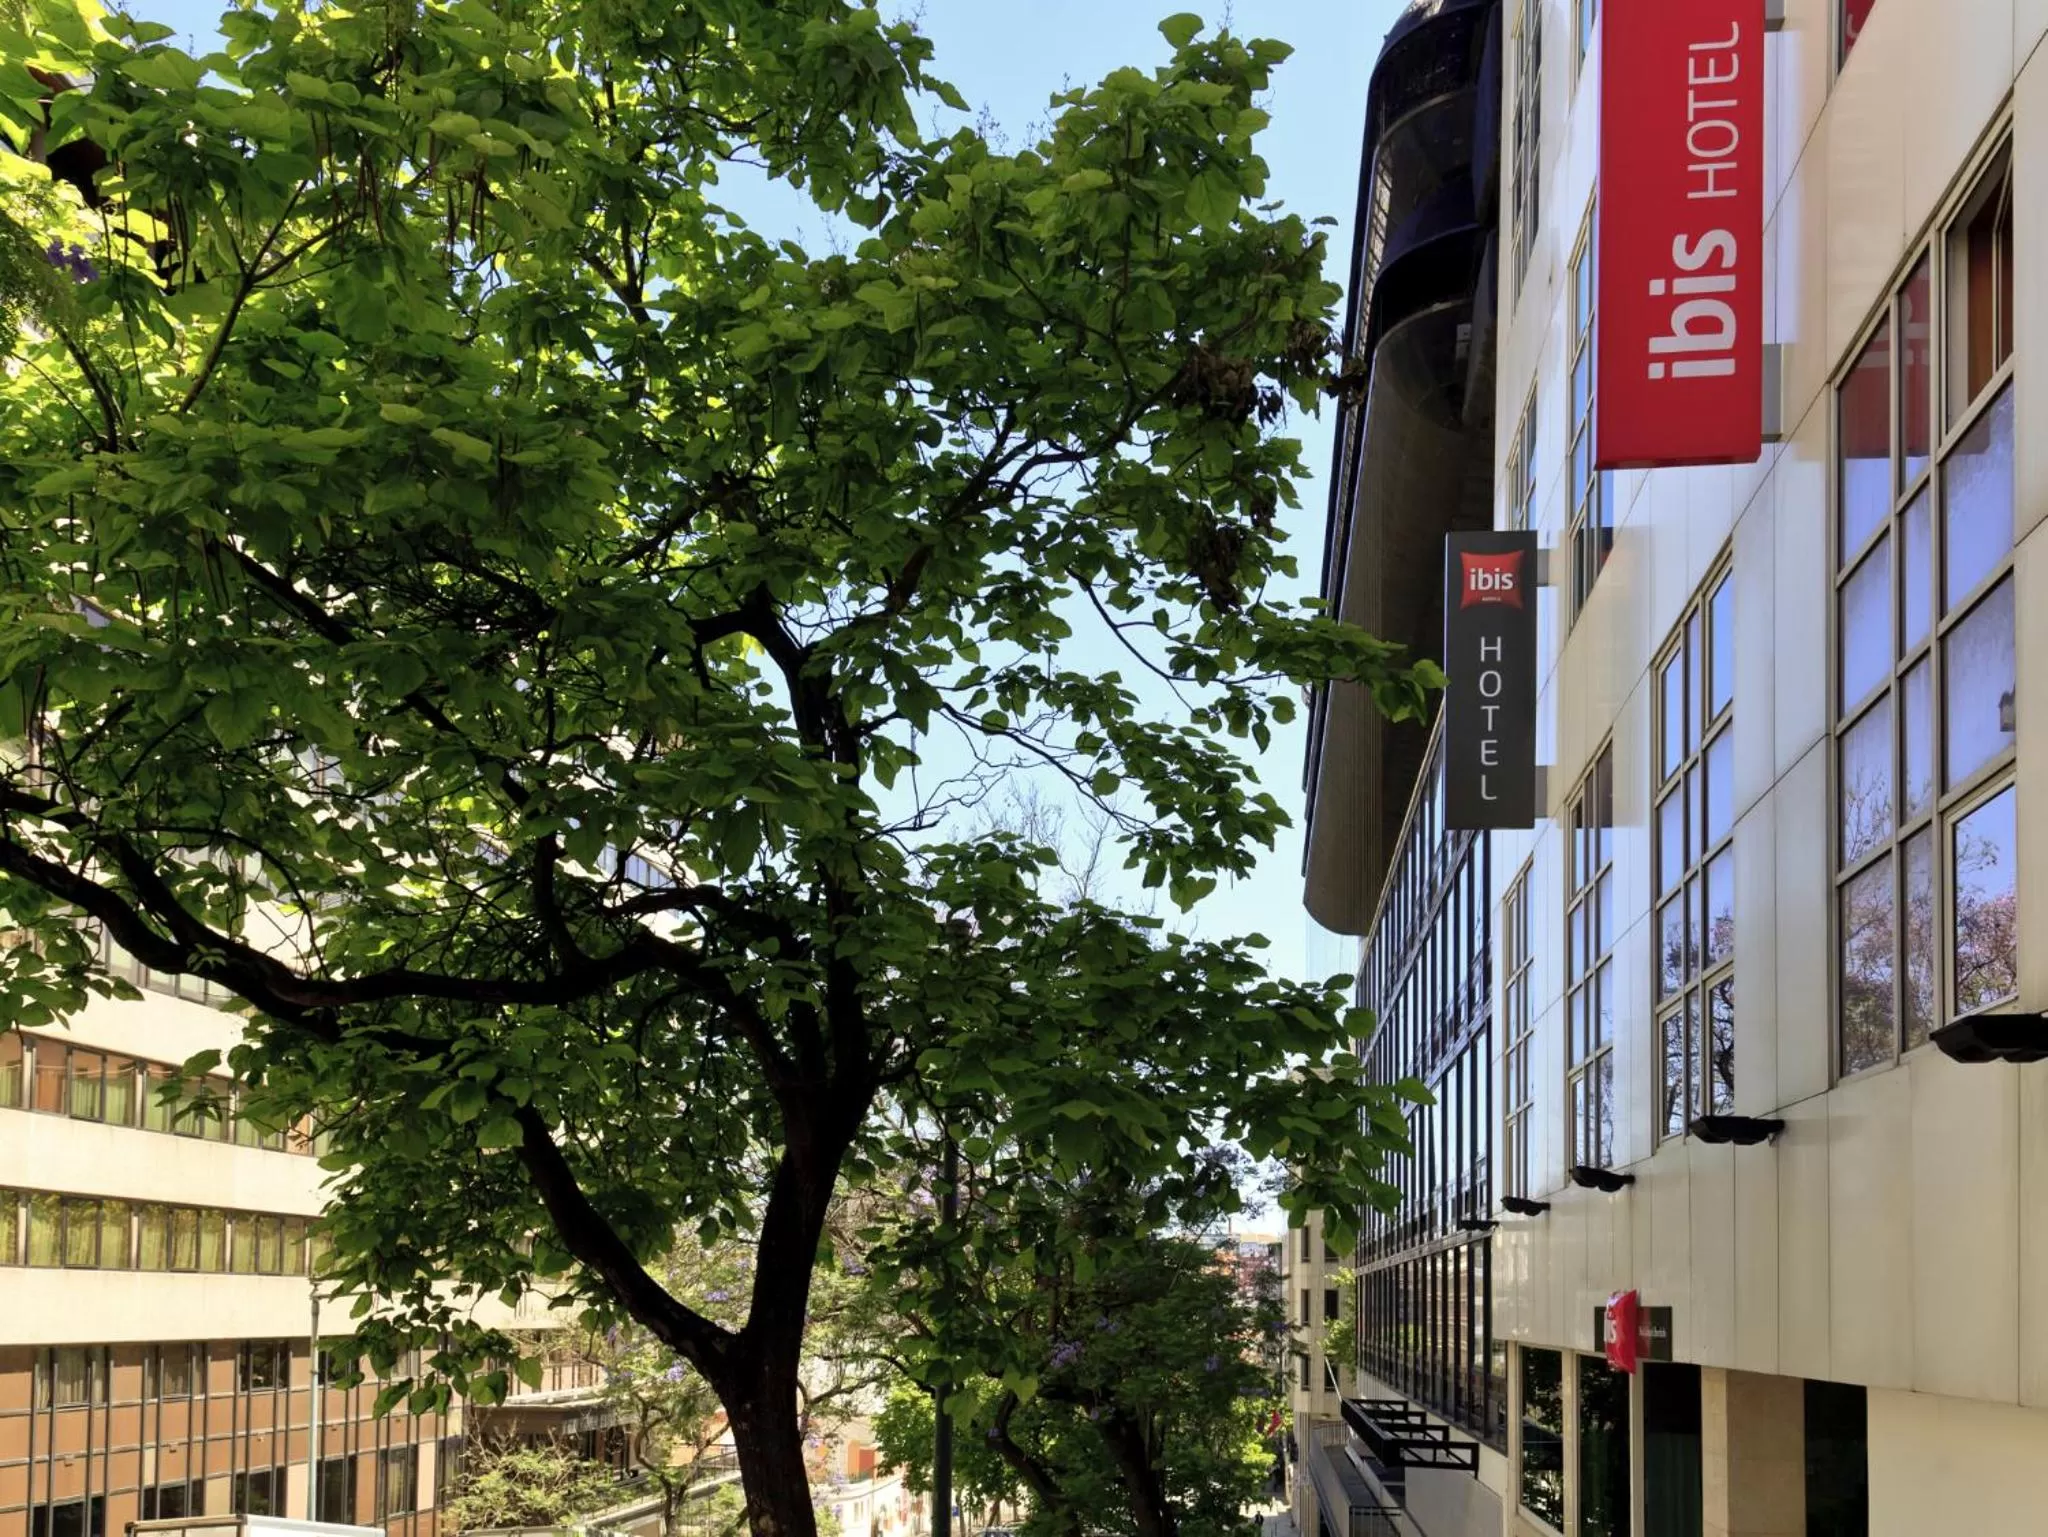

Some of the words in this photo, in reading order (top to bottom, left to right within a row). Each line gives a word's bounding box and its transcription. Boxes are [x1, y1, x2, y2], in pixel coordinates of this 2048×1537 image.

[1686, 21, 1740, 199] HOTEL
[1648, 228, 1737, 380] ibis
[1469, 567, 1513, 590] ibis
[1479, 636, 1502, 799] HOTEL
